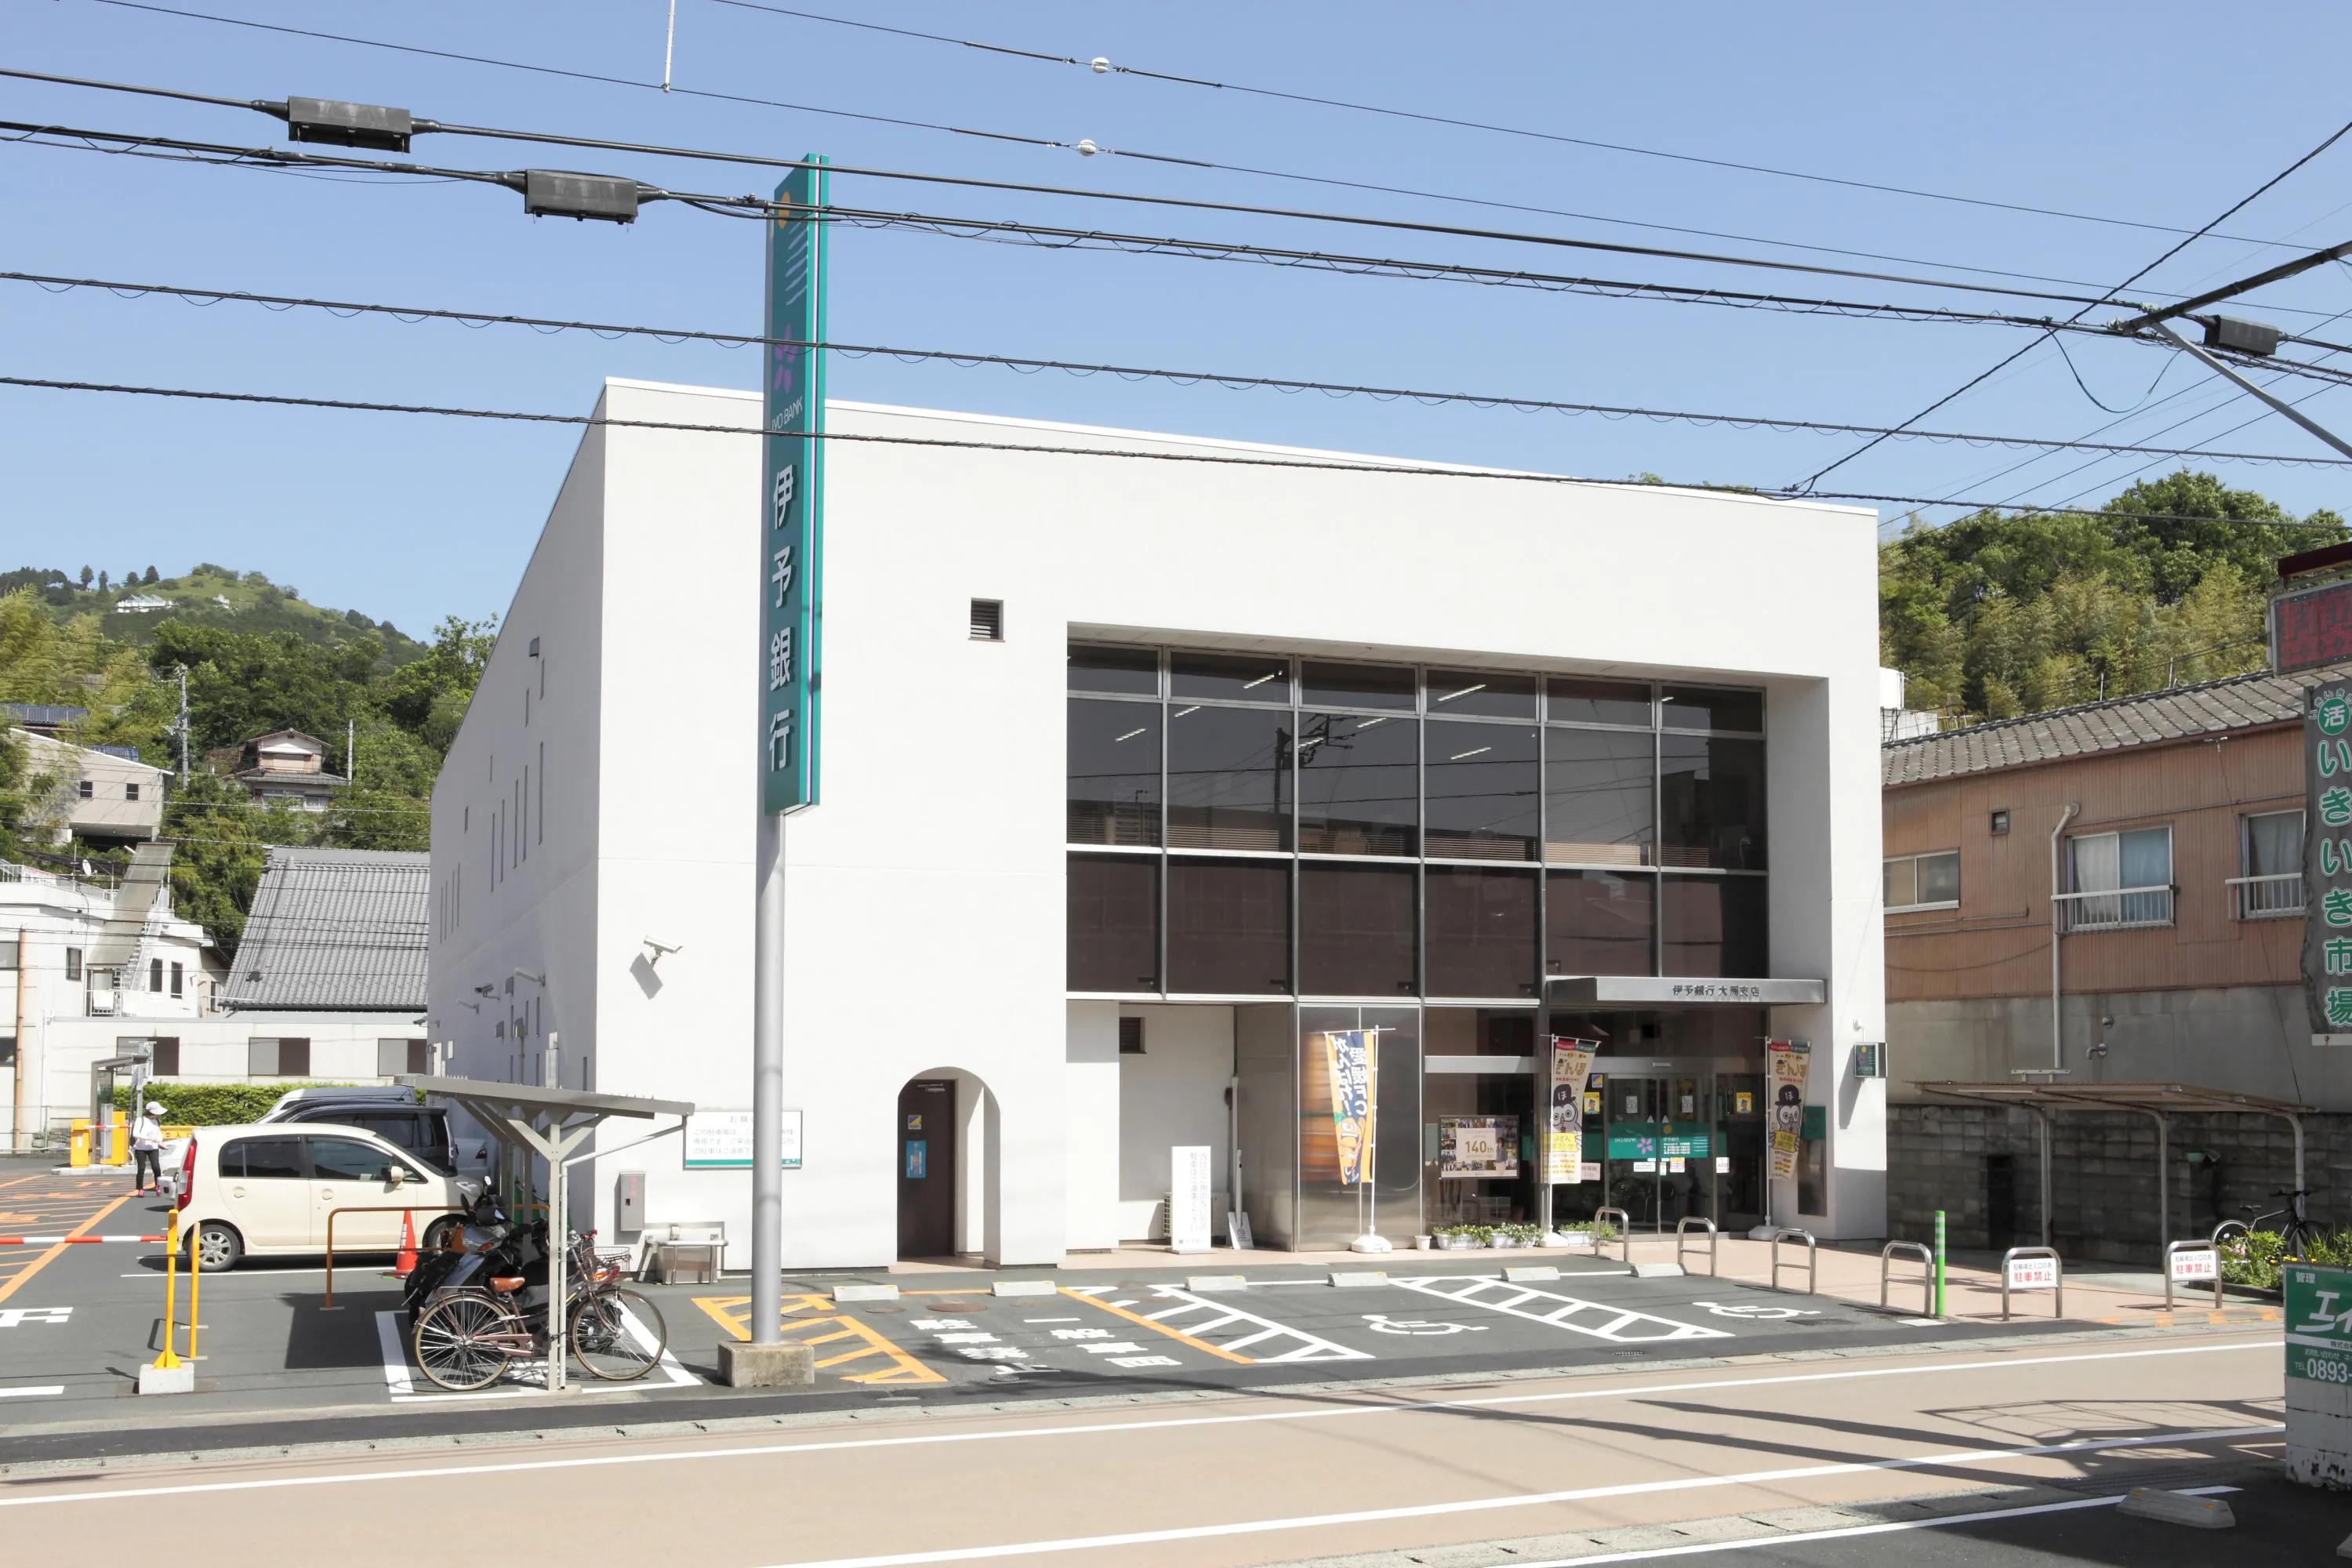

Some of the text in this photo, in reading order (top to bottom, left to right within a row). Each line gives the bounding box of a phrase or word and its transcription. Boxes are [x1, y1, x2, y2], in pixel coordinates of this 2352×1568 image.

[784, 396, 803, 425] BANK
[769, 464, 793, 772] 伊予銀行
[2324, 705, 2345, 728] 活
[2318, 739, 2352, 1028] いきいき市場
[1673, 985, 1715, 996] 伊予銀行
[2176, 1263, 2212, 1274] 駐車禁止
[2013, 1272, 2052, 1283] 駐車禁止
[2296, 1272, 2315, 1283] 管理
[909, 1319, 1061, 1374] 駐車禁止
[2330, 1341, 2352, 1350] 株式会
